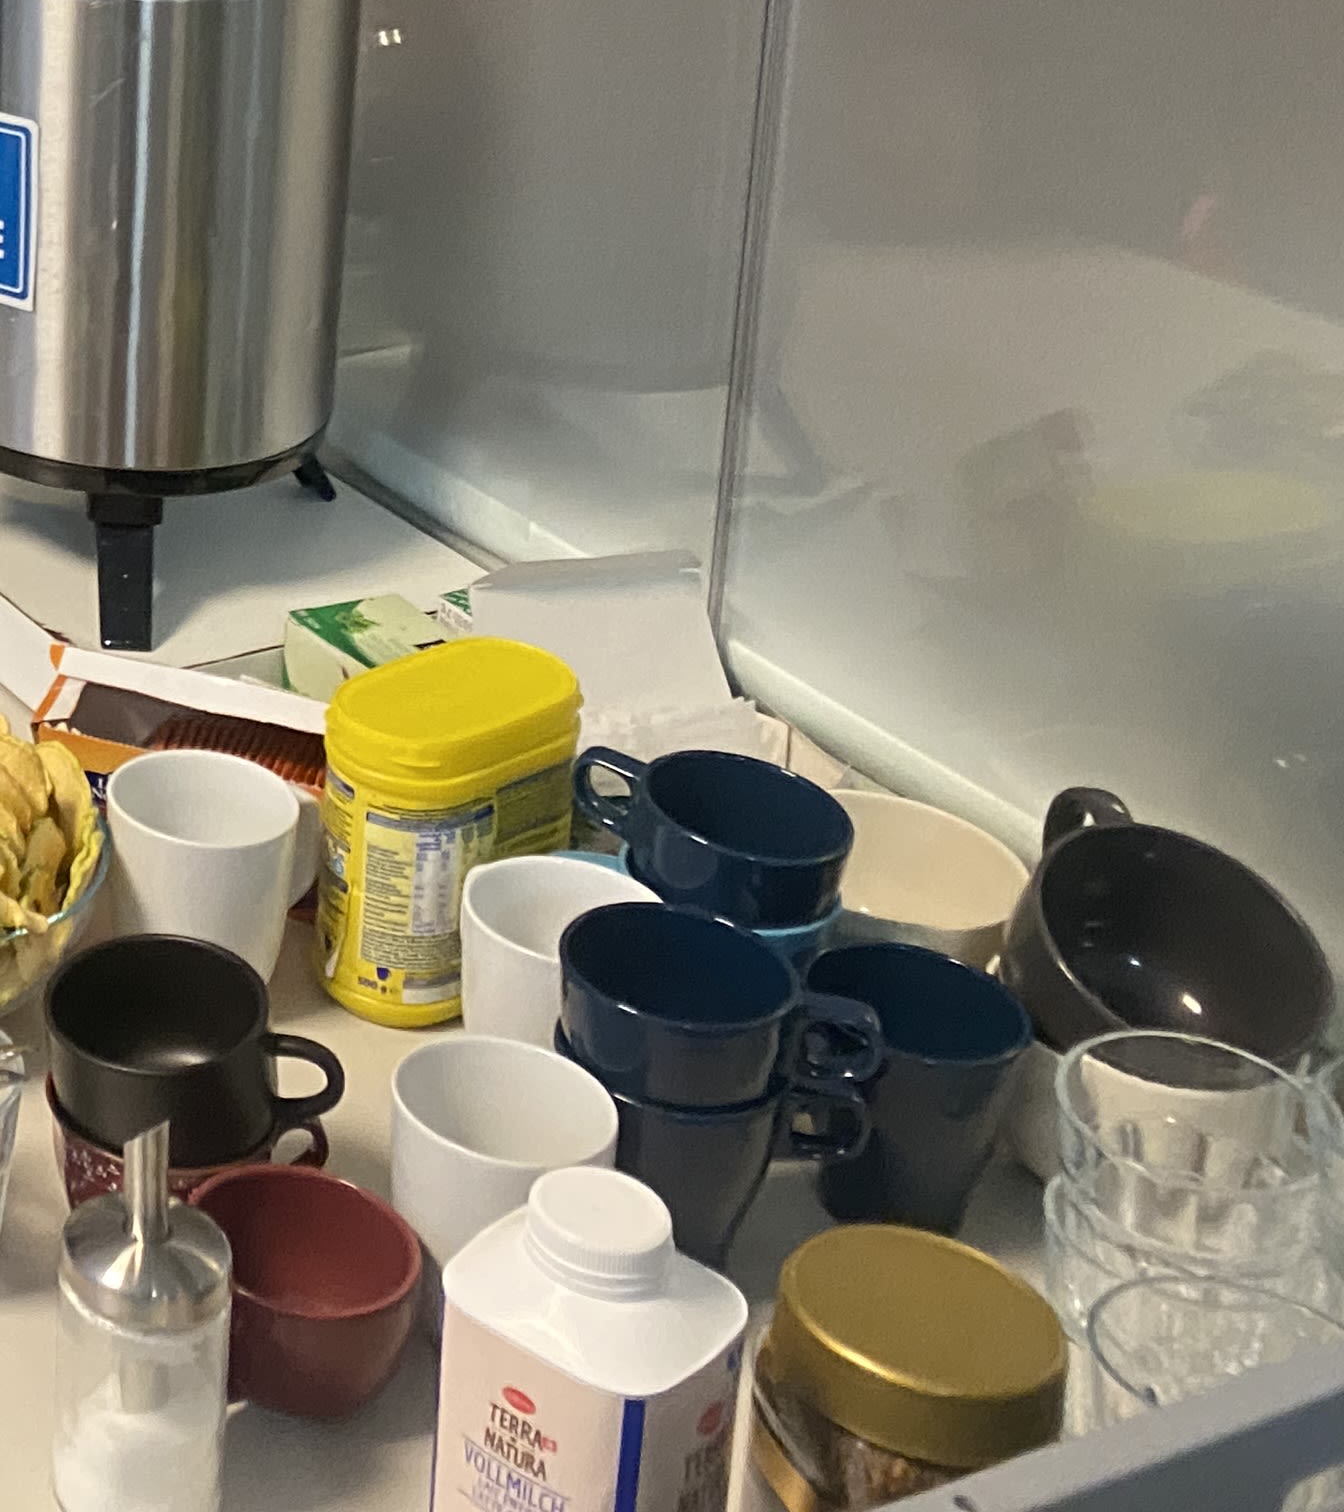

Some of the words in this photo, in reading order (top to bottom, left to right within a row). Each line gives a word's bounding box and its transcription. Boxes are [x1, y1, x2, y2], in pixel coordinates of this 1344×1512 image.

[489, 1401, 543, 1451] TERRA
[464, 1441, 563, 1512] VOLLMILCH
[484, 1427, 546, 1481] NATURA
